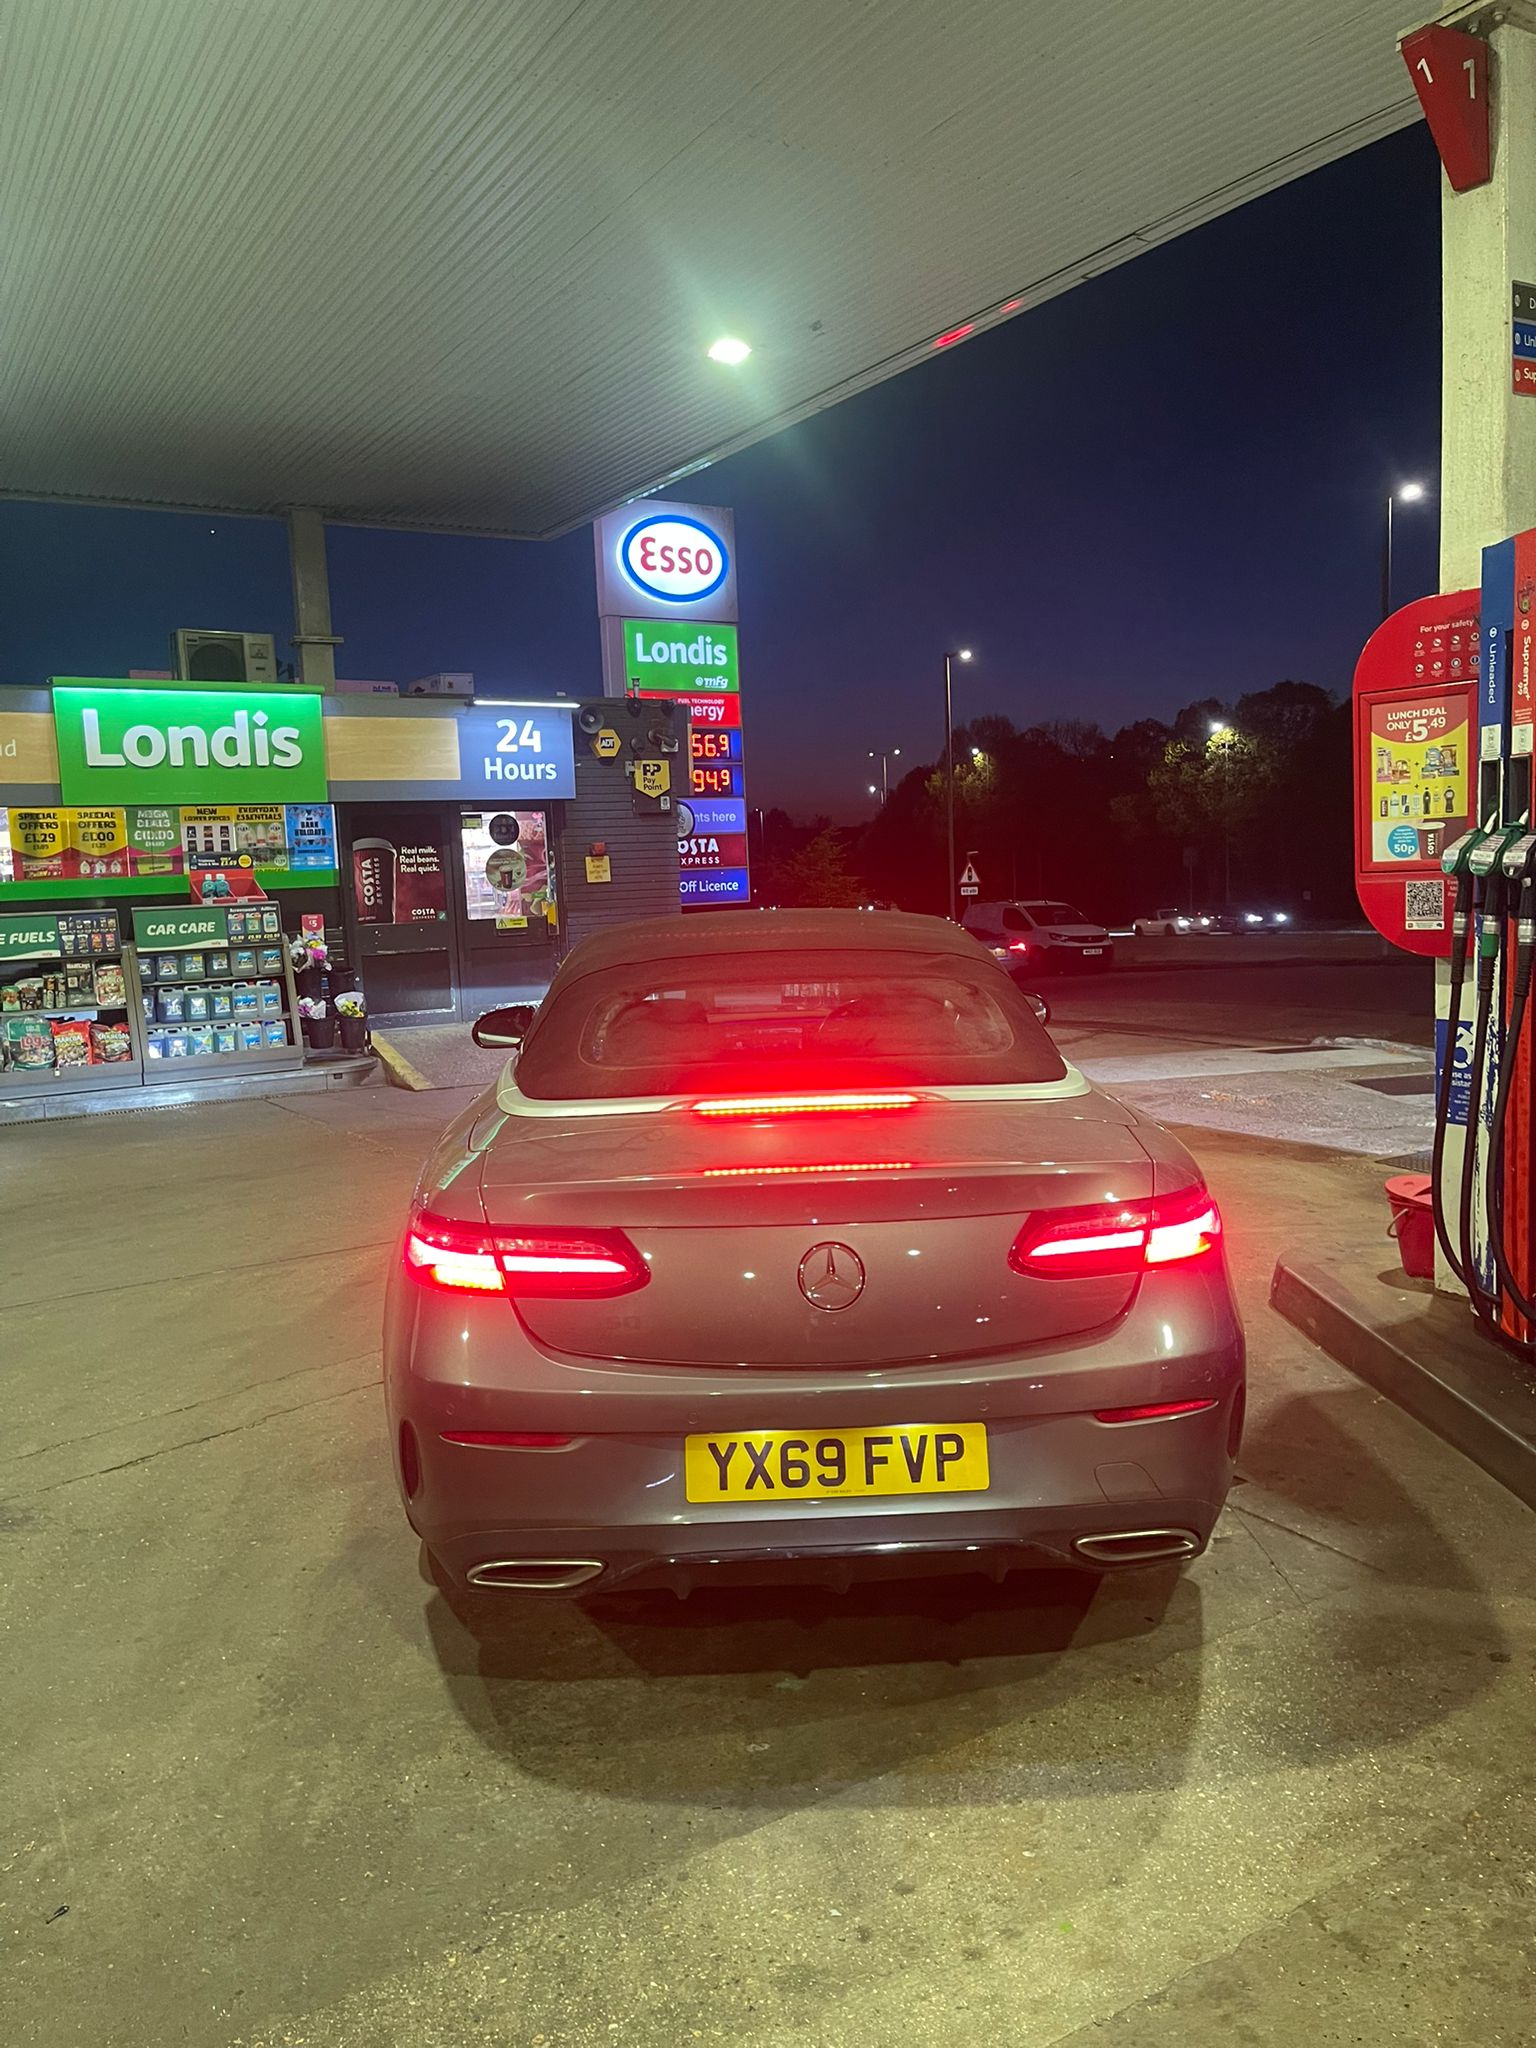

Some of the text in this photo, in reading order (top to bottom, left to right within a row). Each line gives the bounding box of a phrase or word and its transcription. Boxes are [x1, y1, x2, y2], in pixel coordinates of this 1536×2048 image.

[1417, 58, 1433, 84] 1
[1463, 59, 1476, 99] 1
[1523, 367, 1536, 383] Sup
[1420, 619, 1475, 633] For your safety
[635, 632, 728, 666] Londis
[1488, 643, 1497, 704] Unleaded
[1387, 706, 1448, 720] LUNCH DEAL
[1386, 720, 1411, 731] ONLY
[81, 708, 303, 768] Londis
[495, 719, 542, 753] 24
[600, 738, 615, 748] ADT
[484, 757, 557, 781] Hours
[643, 777, 656, 785] Pay
[18, 812, 58, 820] SPECIAL
[77, 811, 116, 819] SPECIAL
[712, 811, 736, 822] here
[18, 821, 59, 830] OFFERS
[78, 820, 117, 829] OFFERS
[24, 832, 56, 843] £1.29
[82, 831, 115, 842] £1.00
[401, 846, 437, 854] Real milk.
[677, 837, 720, 855] OSTA
[1393, 843, 1416, 855] 50p
[1427, 833, 1435, 855] COSTA
[399, 855, 439, 864] Real beans.
[680, 856, 720, 865] XPRESS
[400, 863, 440, 875] Real quick.
[361, 858, 375, 906] COSTA
[679, 880, 739, 893] Off Licence
[411, 908, 435, 916] COSTA
[146, 921, 216, 936] CAR CARE
[9, 931, 56, 945] FUELS
[708, 1433, 965, 1491] YX69 FVP
